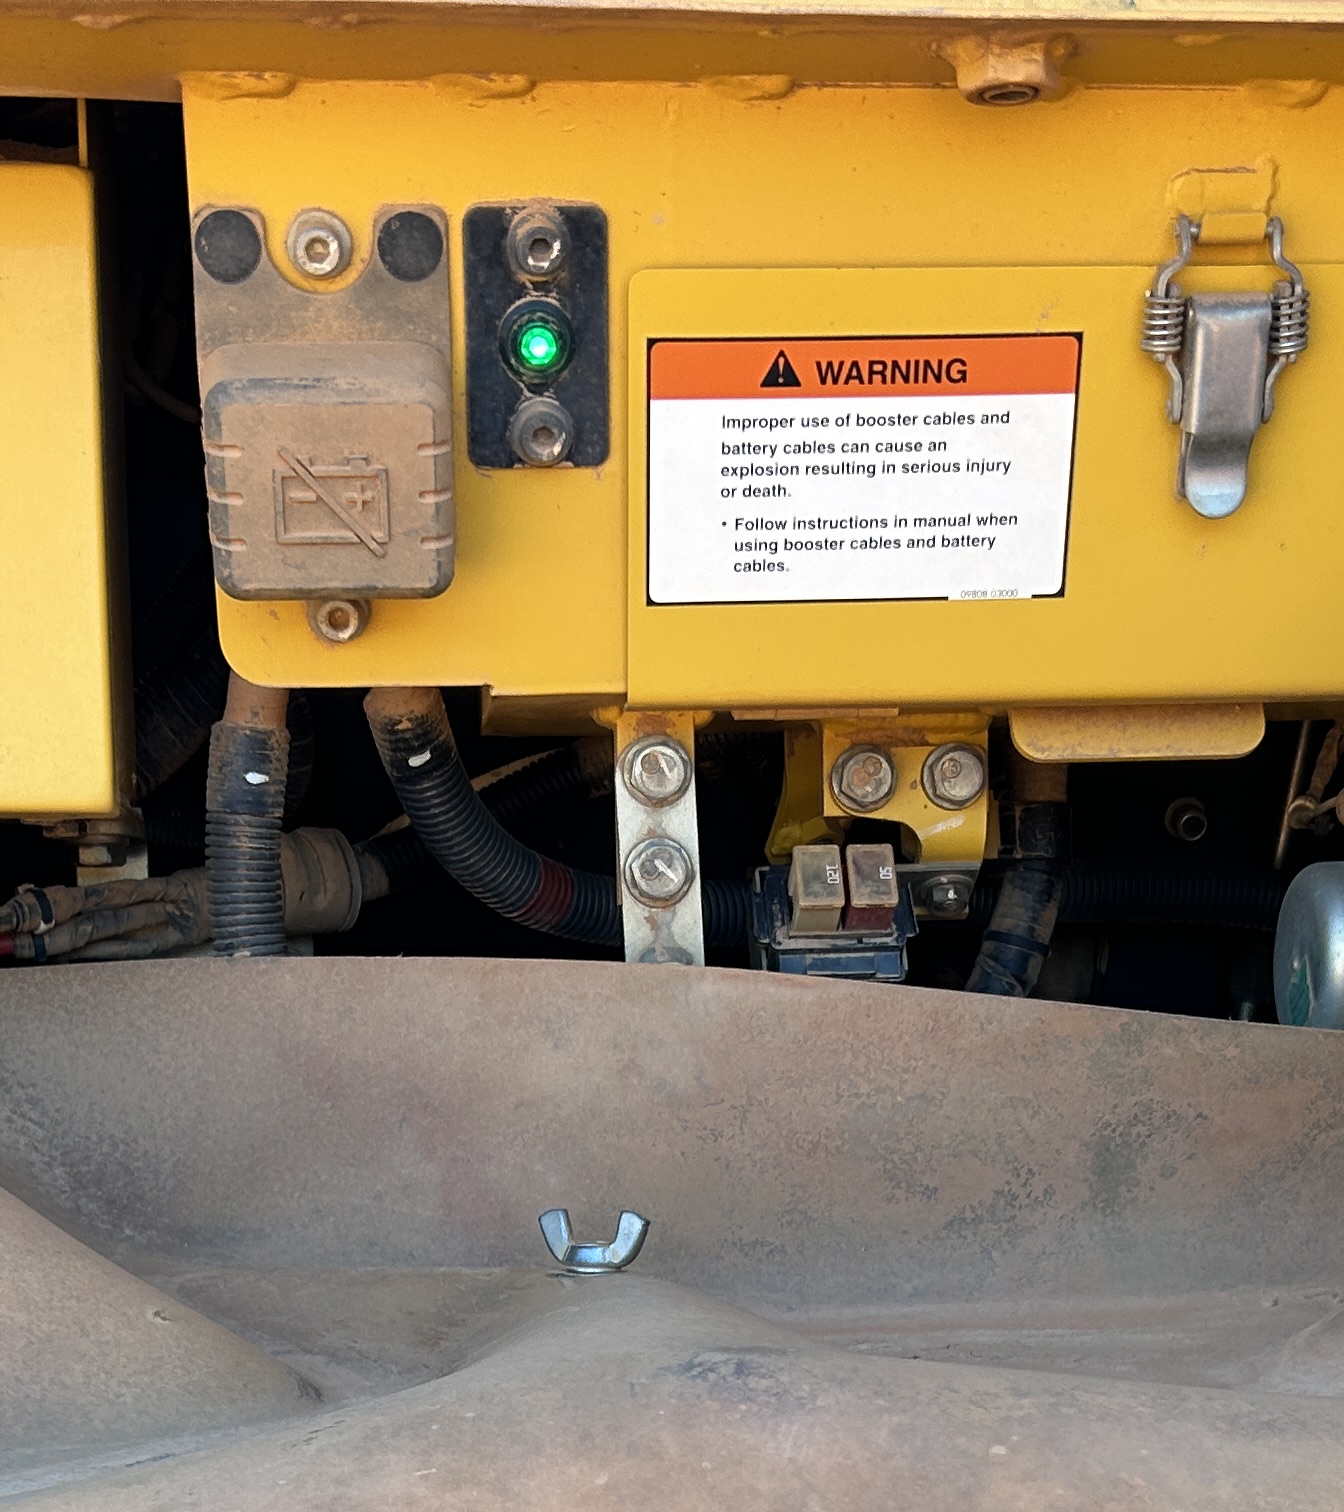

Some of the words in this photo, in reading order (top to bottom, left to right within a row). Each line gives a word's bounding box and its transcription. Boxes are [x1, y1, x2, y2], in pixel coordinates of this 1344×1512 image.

[815, 357, 968, 386] WARNING
[722, 415, 796, 433] Improper
[800, 416, 830, 429] use
[834, 413, 851, 428] of
[855, 413, 919, 427] booster
[922, 411, 976, 426] cables
[980, 410, 1011, 425] and
[721, 441, 778, 459] battery
[782, 440, 836, 455] cables
[840, 442, 870, 454] can
[874, 441, 923, 454] cause
[927, 440, 947, 453] an
[720, 462, 800, 480] explosion
[805, 460, 876, 479] resulting
[881, 460, 896, 475] in
[901, 459, 961, 474] serious
[966, 458, 1012, 476] injury
[720, 487, 738, 499] or
[742, 483, 792, 498] death.
[734, 517, 788, 532] Follow
[792, 515, 889, 531] instructions
[893, 514, 908, 529] in
[913, 513, 971, 528] manual
[975, 512, 1018, 527] when
[734, 538, 779, 555] using
[783, 537, 846, 552] booster
[849, 535, 902, 550] cables
[906, 534, 936, 549] and
[940, 534, 997, 551] battery
[733, 558, 789, 573] cables.
[825, 864, 840, 884] 120
[879, 866, 892, 880] 50
